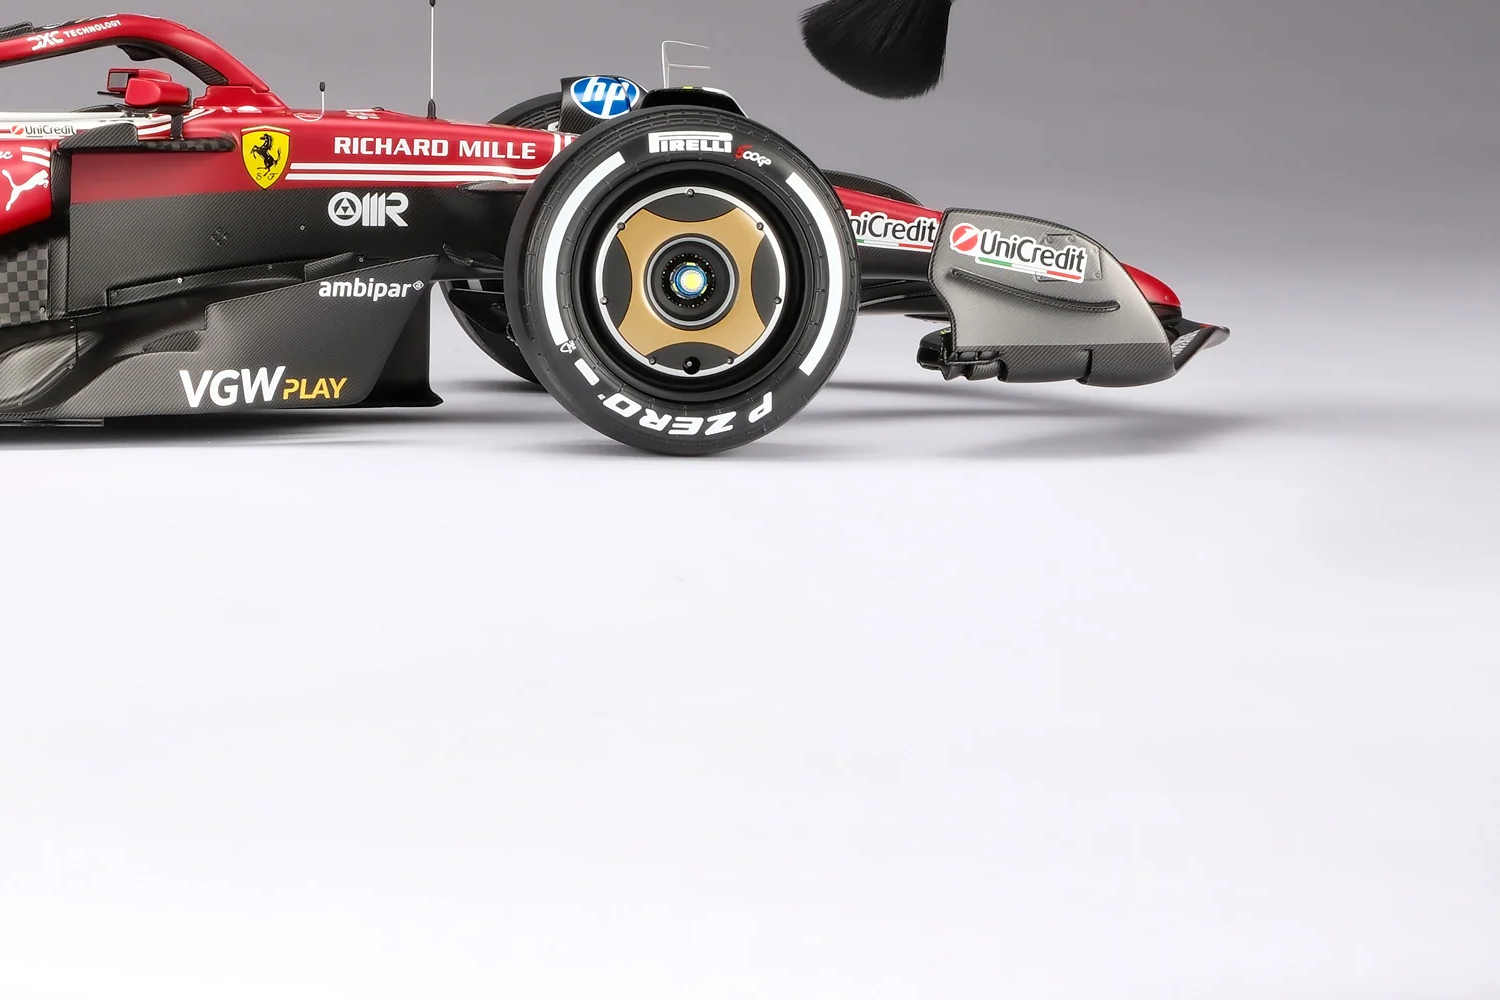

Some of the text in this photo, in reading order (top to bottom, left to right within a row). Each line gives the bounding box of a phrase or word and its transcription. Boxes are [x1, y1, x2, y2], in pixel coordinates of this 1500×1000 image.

[63, 19, 122, 38] TECHNOLOGY
[25, 125, 76, 135] UniCredit
[648, 131, 733, 153] PIRELLI
[334, 136, 536, 160] RICHARD MILLE
[850, 214, 936, 243] niCredit
[980, 229, 1085, 273] UniCredit
[319, 277, 412, 302] ambipar
[179, 366, 348, 407] VGW PLAY
[602, 391, 773, 436] P ZERO
